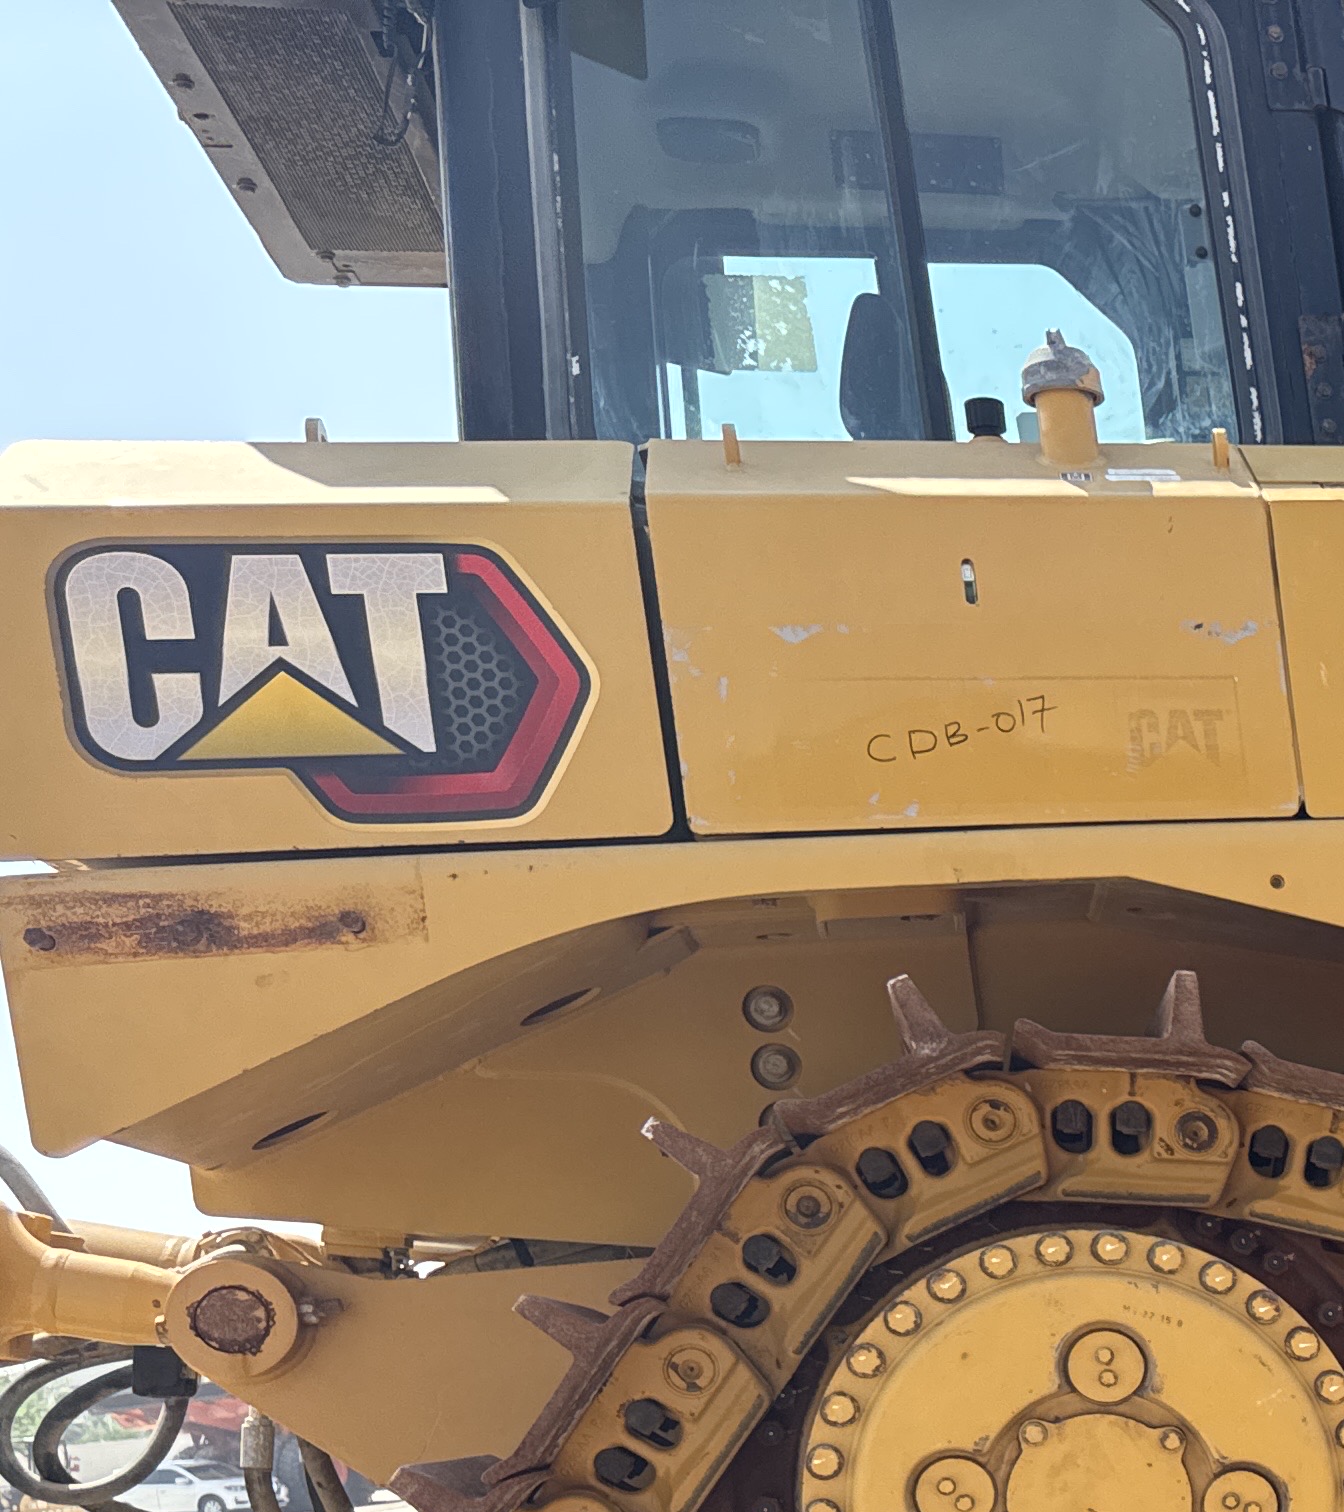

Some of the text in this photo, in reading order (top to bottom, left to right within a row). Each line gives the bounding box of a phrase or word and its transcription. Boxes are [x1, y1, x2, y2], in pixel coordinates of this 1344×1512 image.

[65, 551, 448, 760] CAT
[866, 694, 1058, 763] CDB-017
[1126, 708, 1224, 774] CAT
